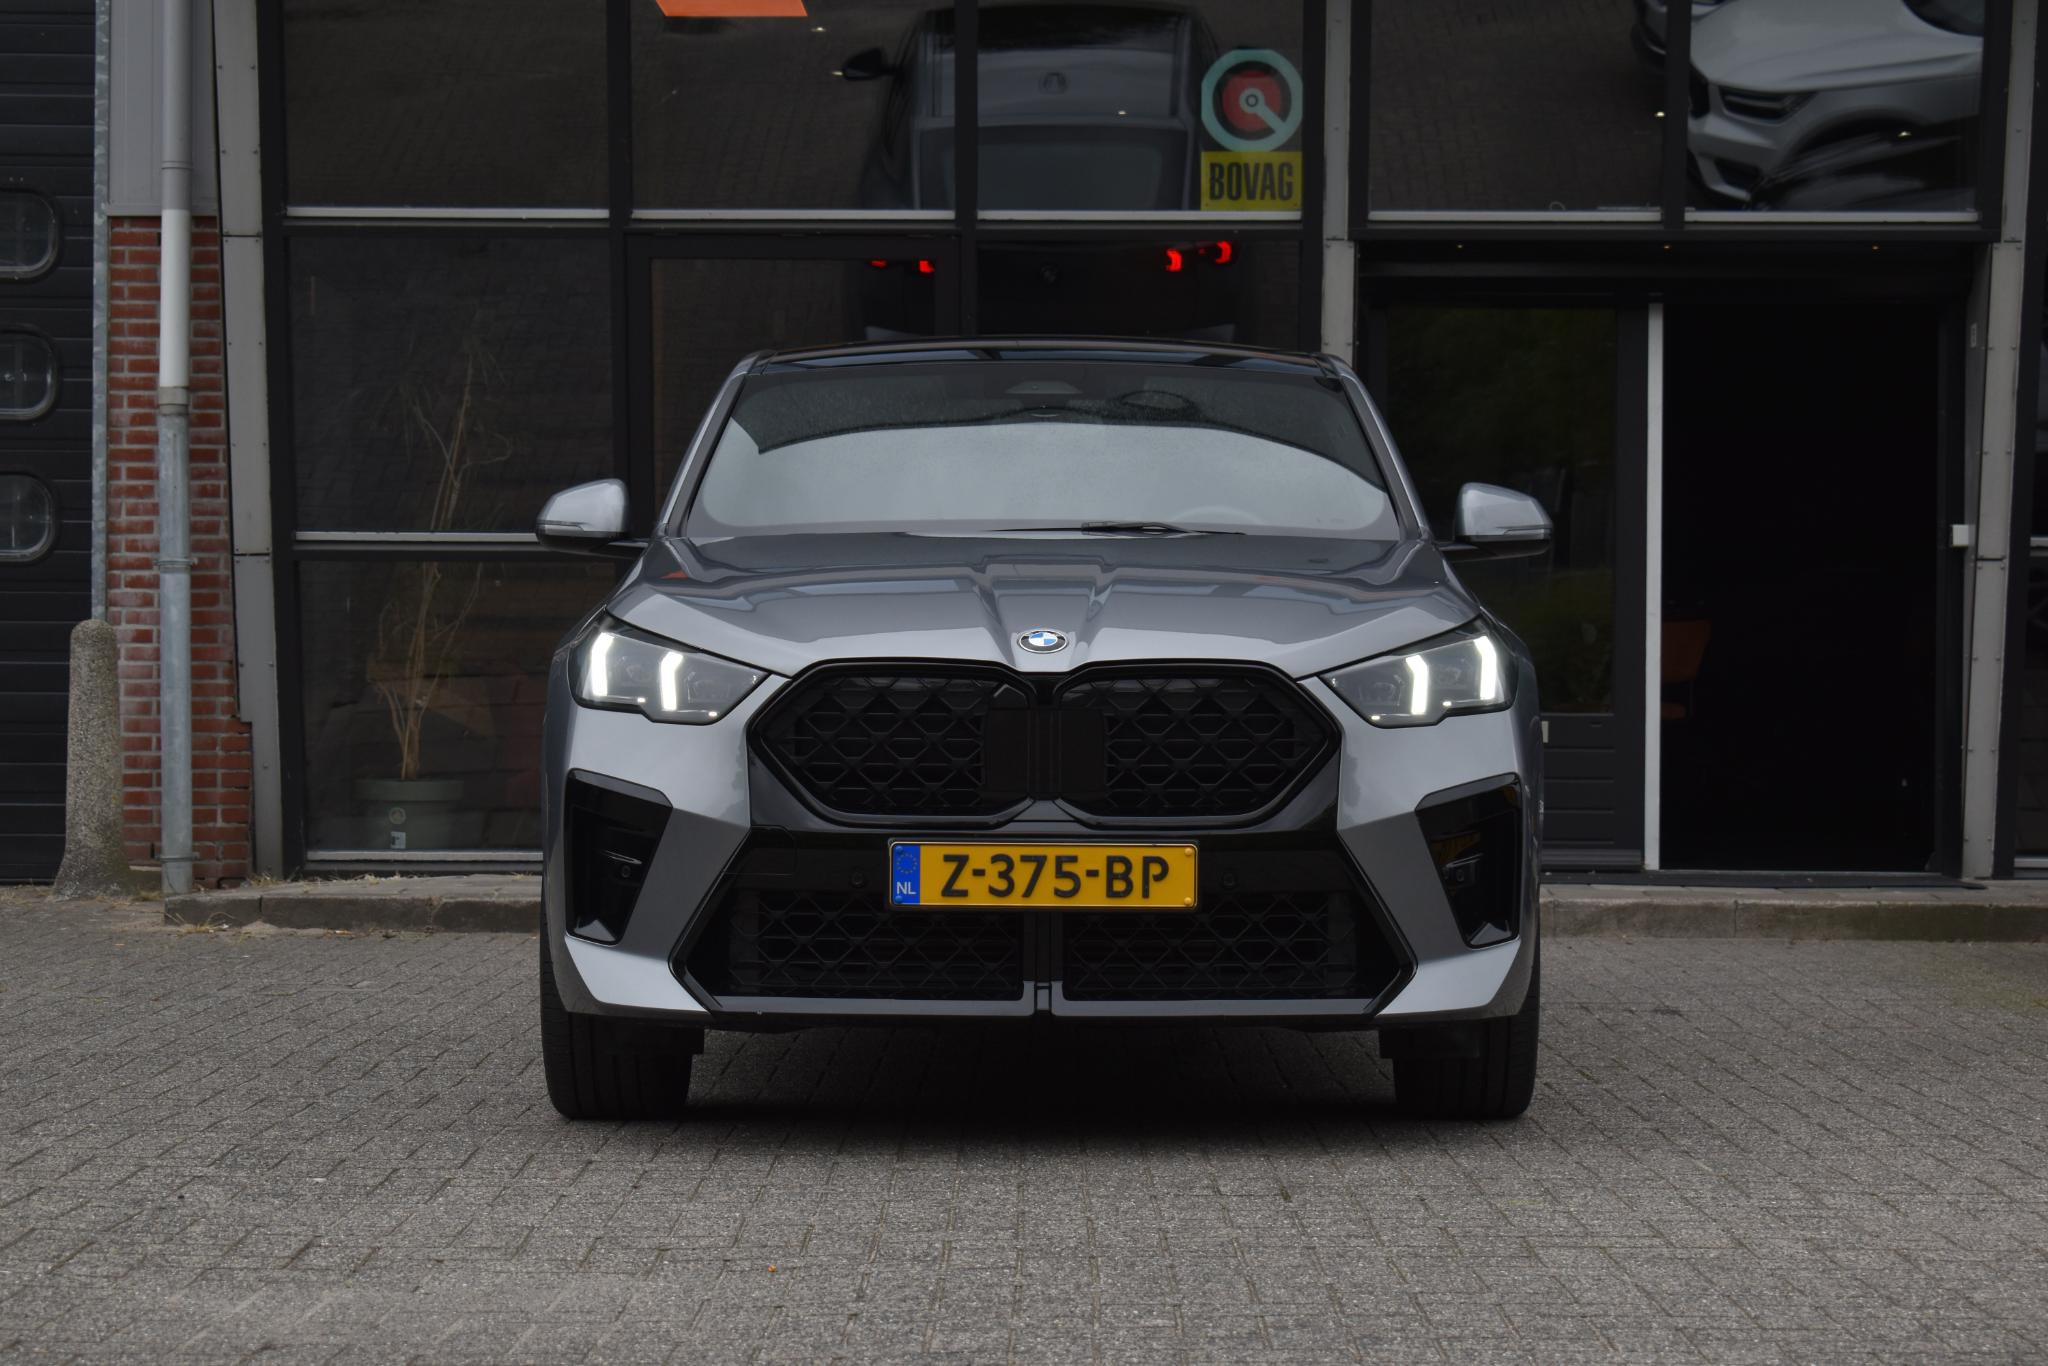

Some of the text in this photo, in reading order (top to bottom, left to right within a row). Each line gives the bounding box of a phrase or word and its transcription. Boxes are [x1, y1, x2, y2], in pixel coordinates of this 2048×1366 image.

[1209, 162, 1294, 201] BOVAG
[896, 881, 916, 895] NL
[940, 853, 1170, 899] Z-375-BP
